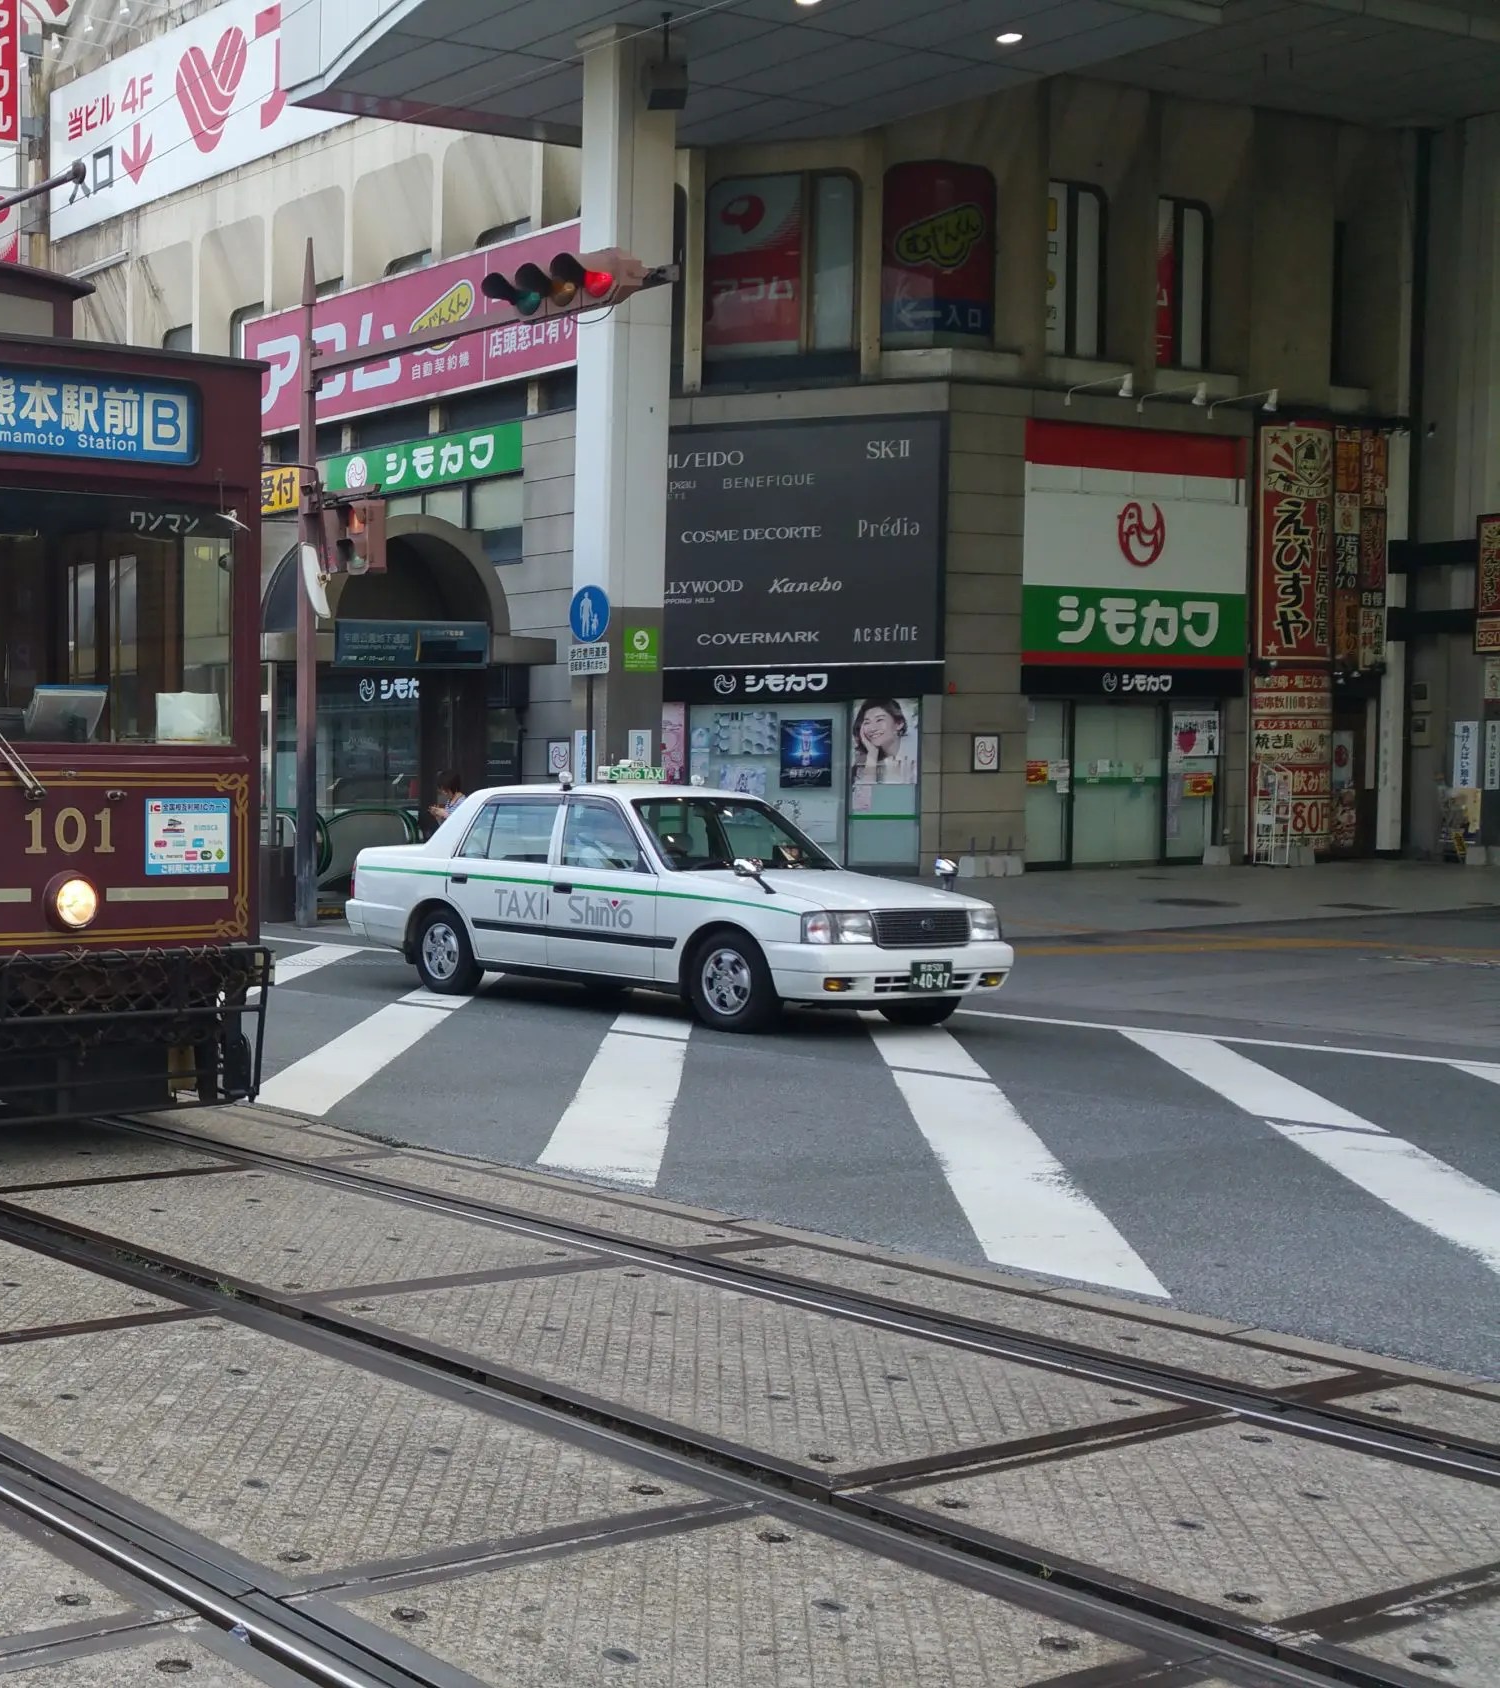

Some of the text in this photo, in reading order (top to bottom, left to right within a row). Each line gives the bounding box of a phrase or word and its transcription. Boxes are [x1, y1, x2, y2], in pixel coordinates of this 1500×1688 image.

[68, 73, 153, 141] 当ビル 4F
[946, 304, 982, 328] 入口
[489, 316, 574, 358] 店頭窓口有り
[411, 352, 470, 380] 自動契約機
[152, 399, 181, 446] B
[77, 433, 137, 452] Station
[386, 434, 495, 484] シモカワ
[722, 473, 816, 490] BENEFIQUE
[130, 511, 199, 533] ワンマン
[857, 517, 921, 538] Prédia
[680, 525, 822, 544] COSME DECORTE
[1273, 498, 1312, 648] えびすや
[768, 576, 843, 594] Kanebo
[1058, 596, 1219, 647] シモカワ
[697, 631, 820, 646] COVERMARK
[744, 673, 829, 693] シモカワ
[1122, 674, 1172, 692] シモカワ
[1255, 733, 1294, 749] 焼き鳥
[643, 768, 665, 780] TAXI
[25, 807, 115, 854] 101
[495, 889, 545, 921] TAXI
[919, 972, 951, 988] 40-47
